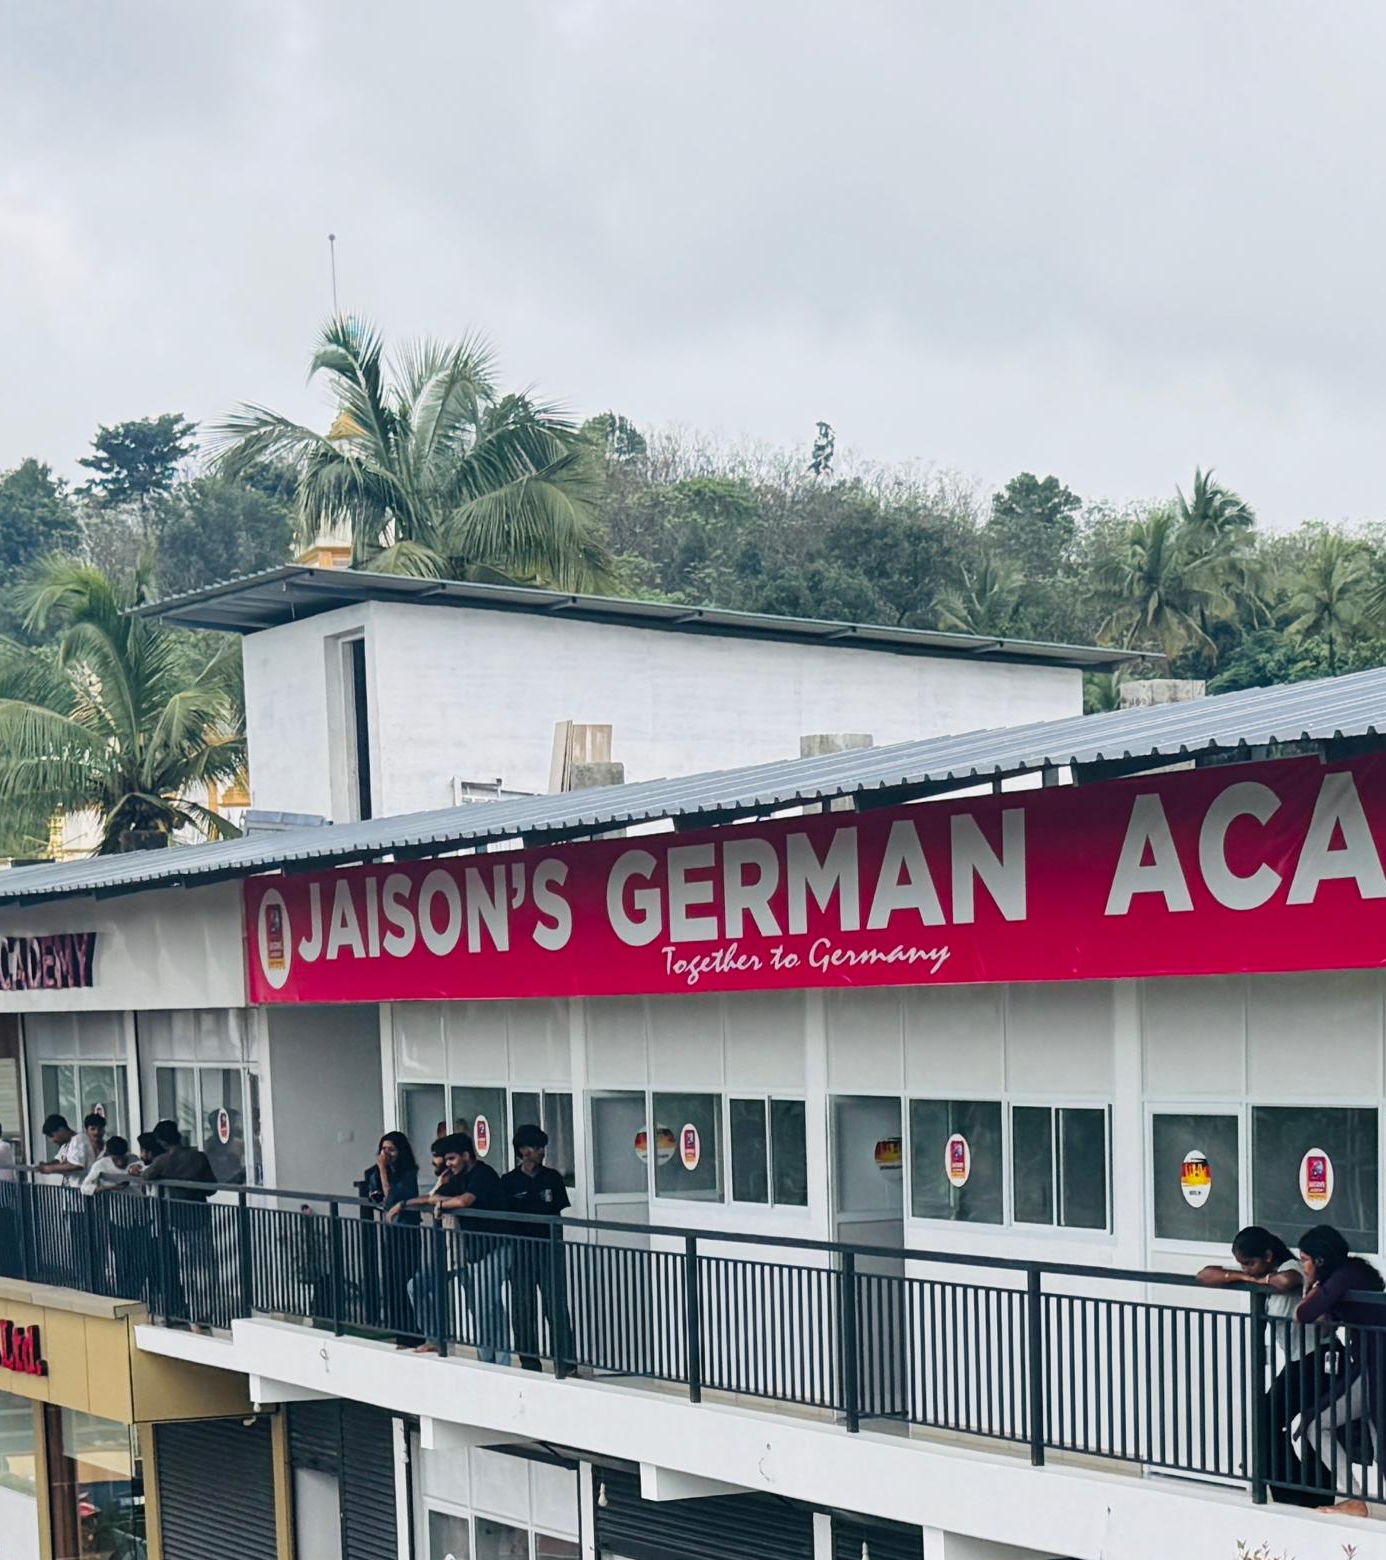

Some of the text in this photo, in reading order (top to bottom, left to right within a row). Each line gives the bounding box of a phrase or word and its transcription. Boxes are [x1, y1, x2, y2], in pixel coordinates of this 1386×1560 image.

[298, 861, 572, 963] JAISON'S
[606, 807, 1028, 948] GERMAN
[661, 937, 951, 985] Together to Germany
